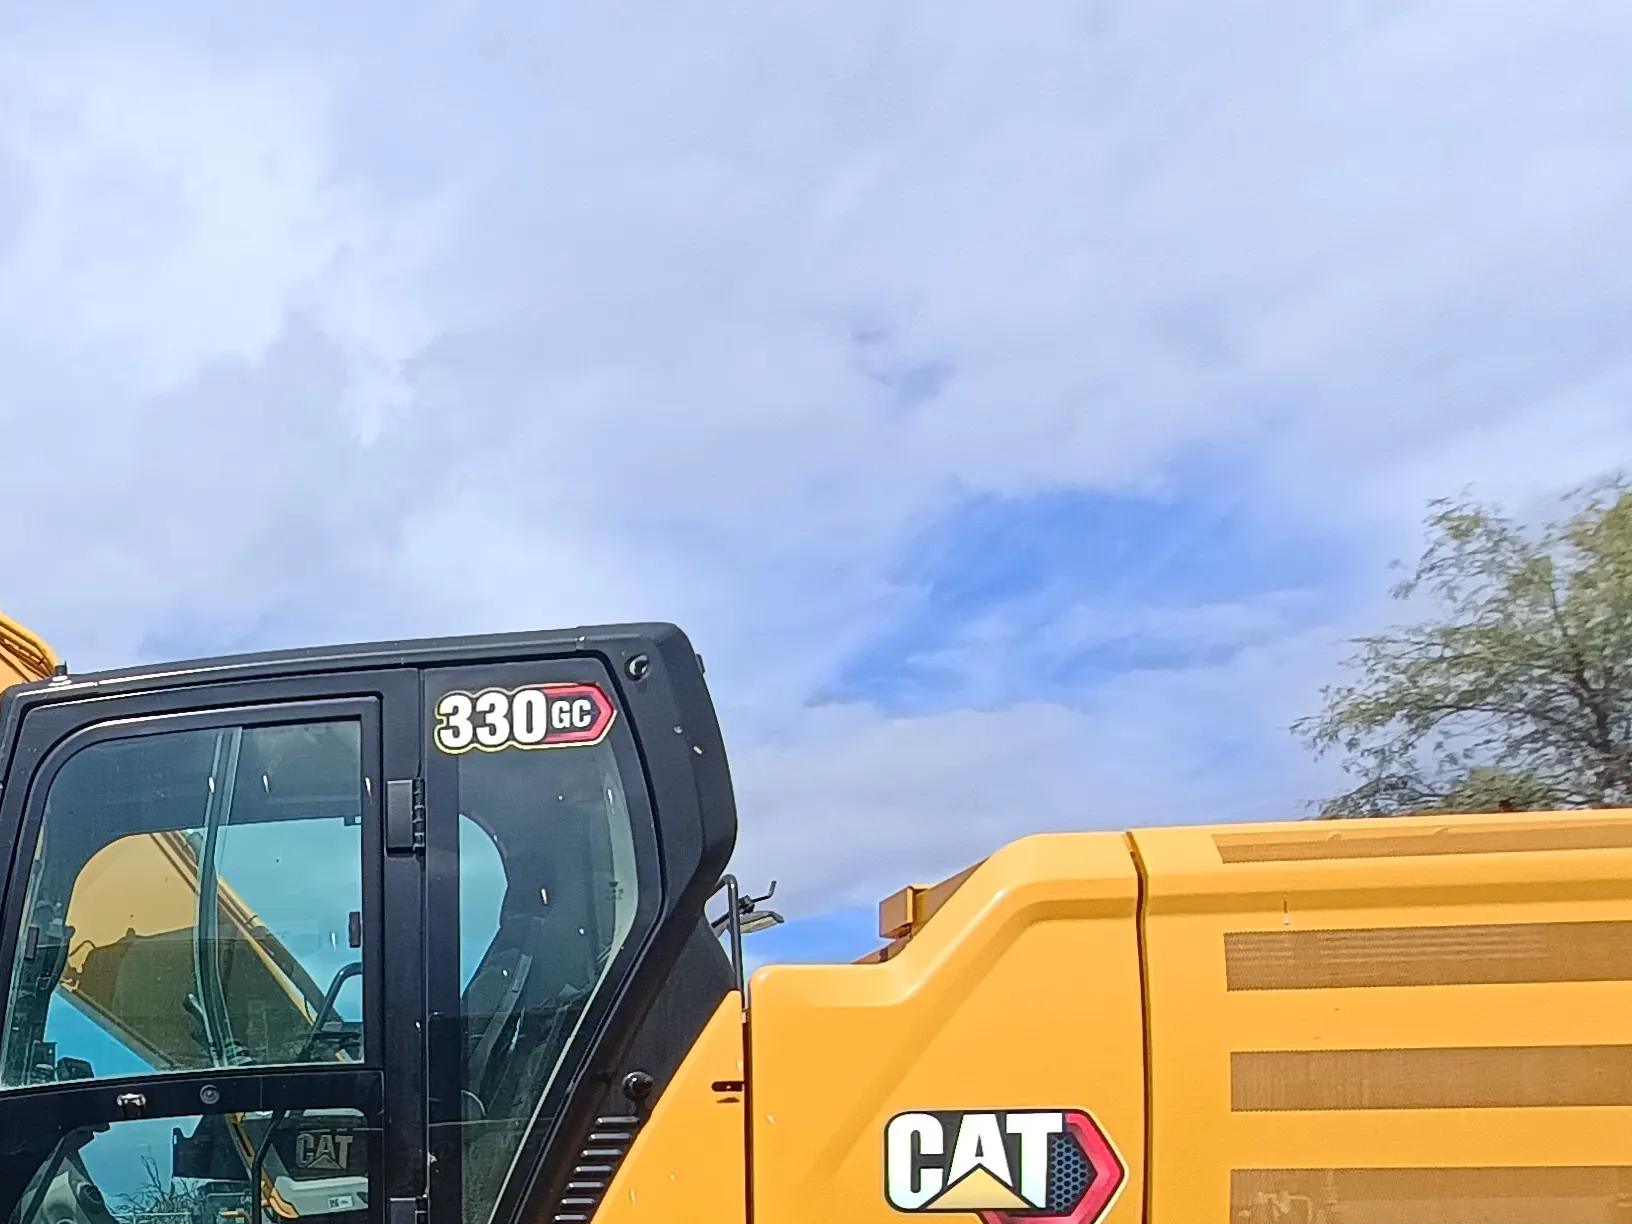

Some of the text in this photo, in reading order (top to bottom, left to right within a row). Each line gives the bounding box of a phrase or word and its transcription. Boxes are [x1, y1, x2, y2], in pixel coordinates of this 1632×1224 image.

[439, 689, 592, 748] 330 GC
[296, 1133, 354, 1170] CAT
[887, 1112, 1063, 1210] CAT
